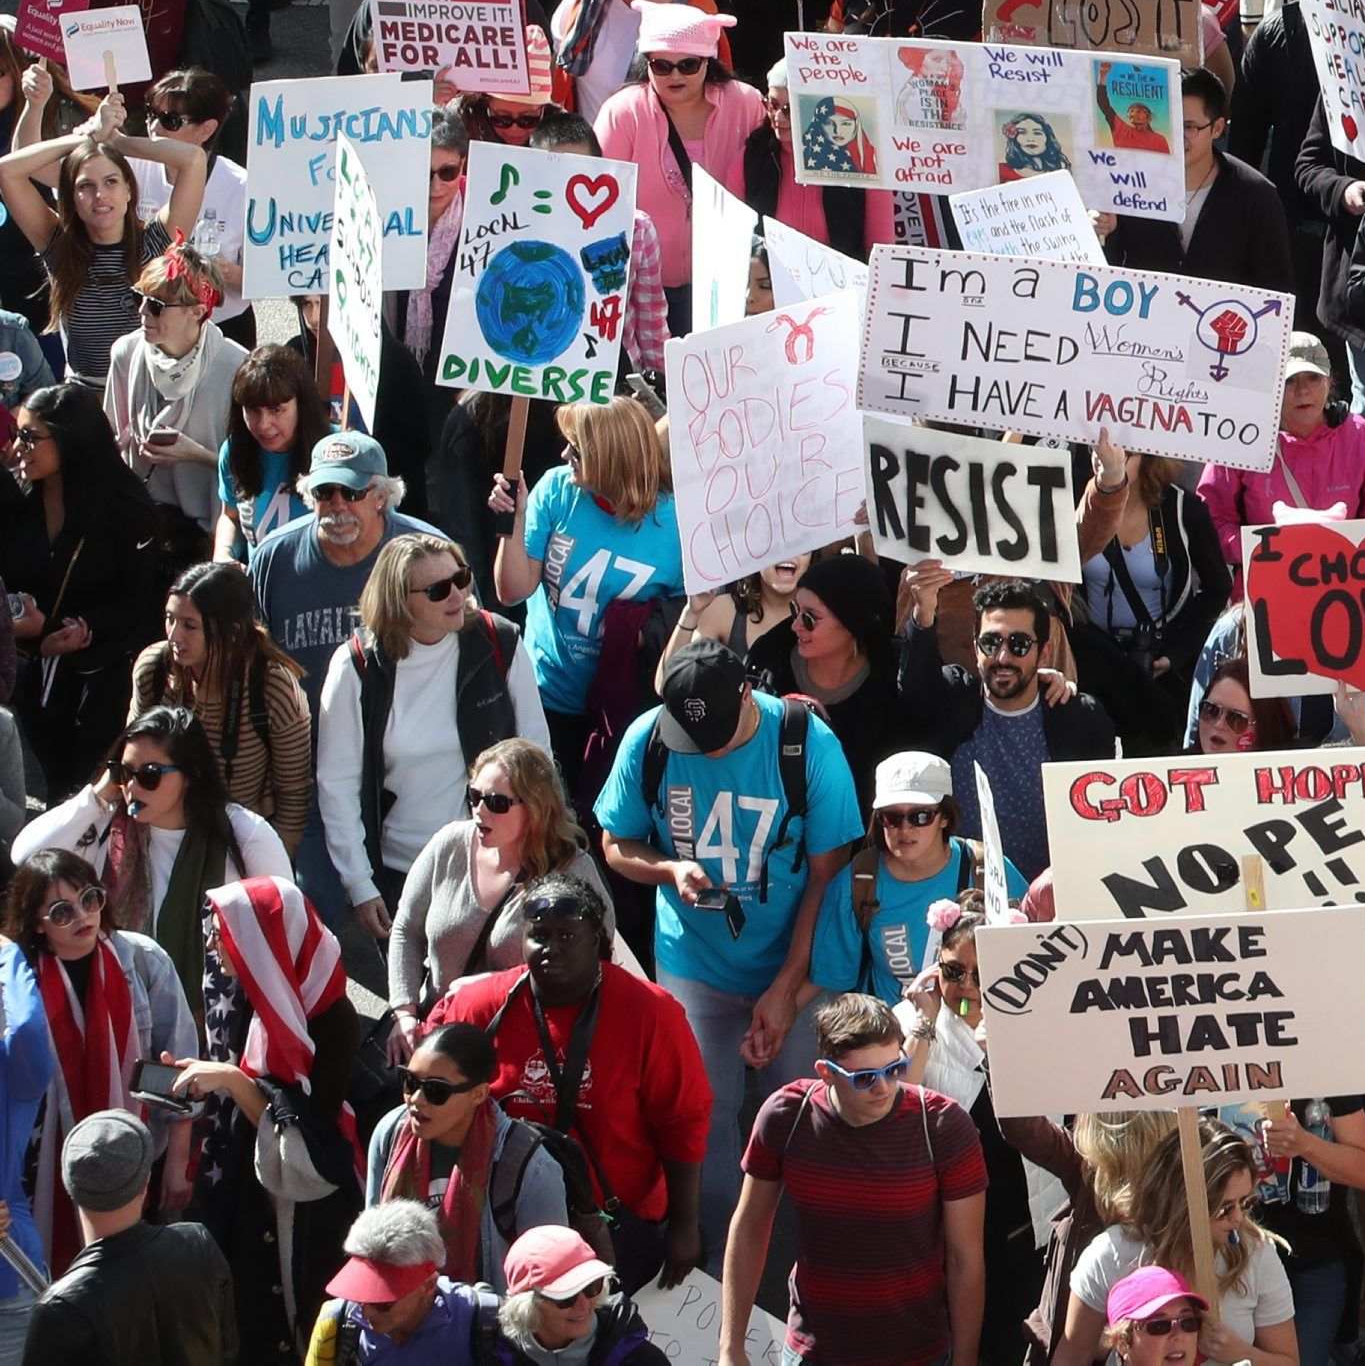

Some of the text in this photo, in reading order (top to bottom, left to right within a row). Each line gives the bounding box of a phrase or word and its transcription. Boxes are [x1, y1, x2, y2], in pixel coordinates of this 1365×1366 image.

[79, 18, 116, 34] Equality
[116, 16, 136, 29] Now
[380, 20, 516, 47] MEDICARE
[383, 44, 519, 70] FOR ALL!
[800, 66, 867, 85] people
[984, 47, 1063, 68] We will
[1111, 78, 1165, 100] RESILIENT
[1112, 190, 1168, 212] defend
[464, 210, 530, 243] LOCAL
[890, 256, 1159, 320] I'm a BOY
[589, 294, 623, 341] 47
[443, 353, 614, 405] DIVERSE
[682, 344, 757, 412] OUR
[883, 370, 1260, 447] I HAVE A VAGINA TOO
[689, 467, 861, 582] CHOICE
[869, 443, 1066, 564] RESIST
[1251, 527, 1283, 563] I
[670, 787, 692, 837] LOCAL
[1069, 766, 1220, 824] GOT
[695, 790, 780, 882] 47
[1097, 925, 1267, 970] MAKE
[1069, 971, 1284, 1014] AMERICA
[1128, 1011, 1299, 1058] HATE
